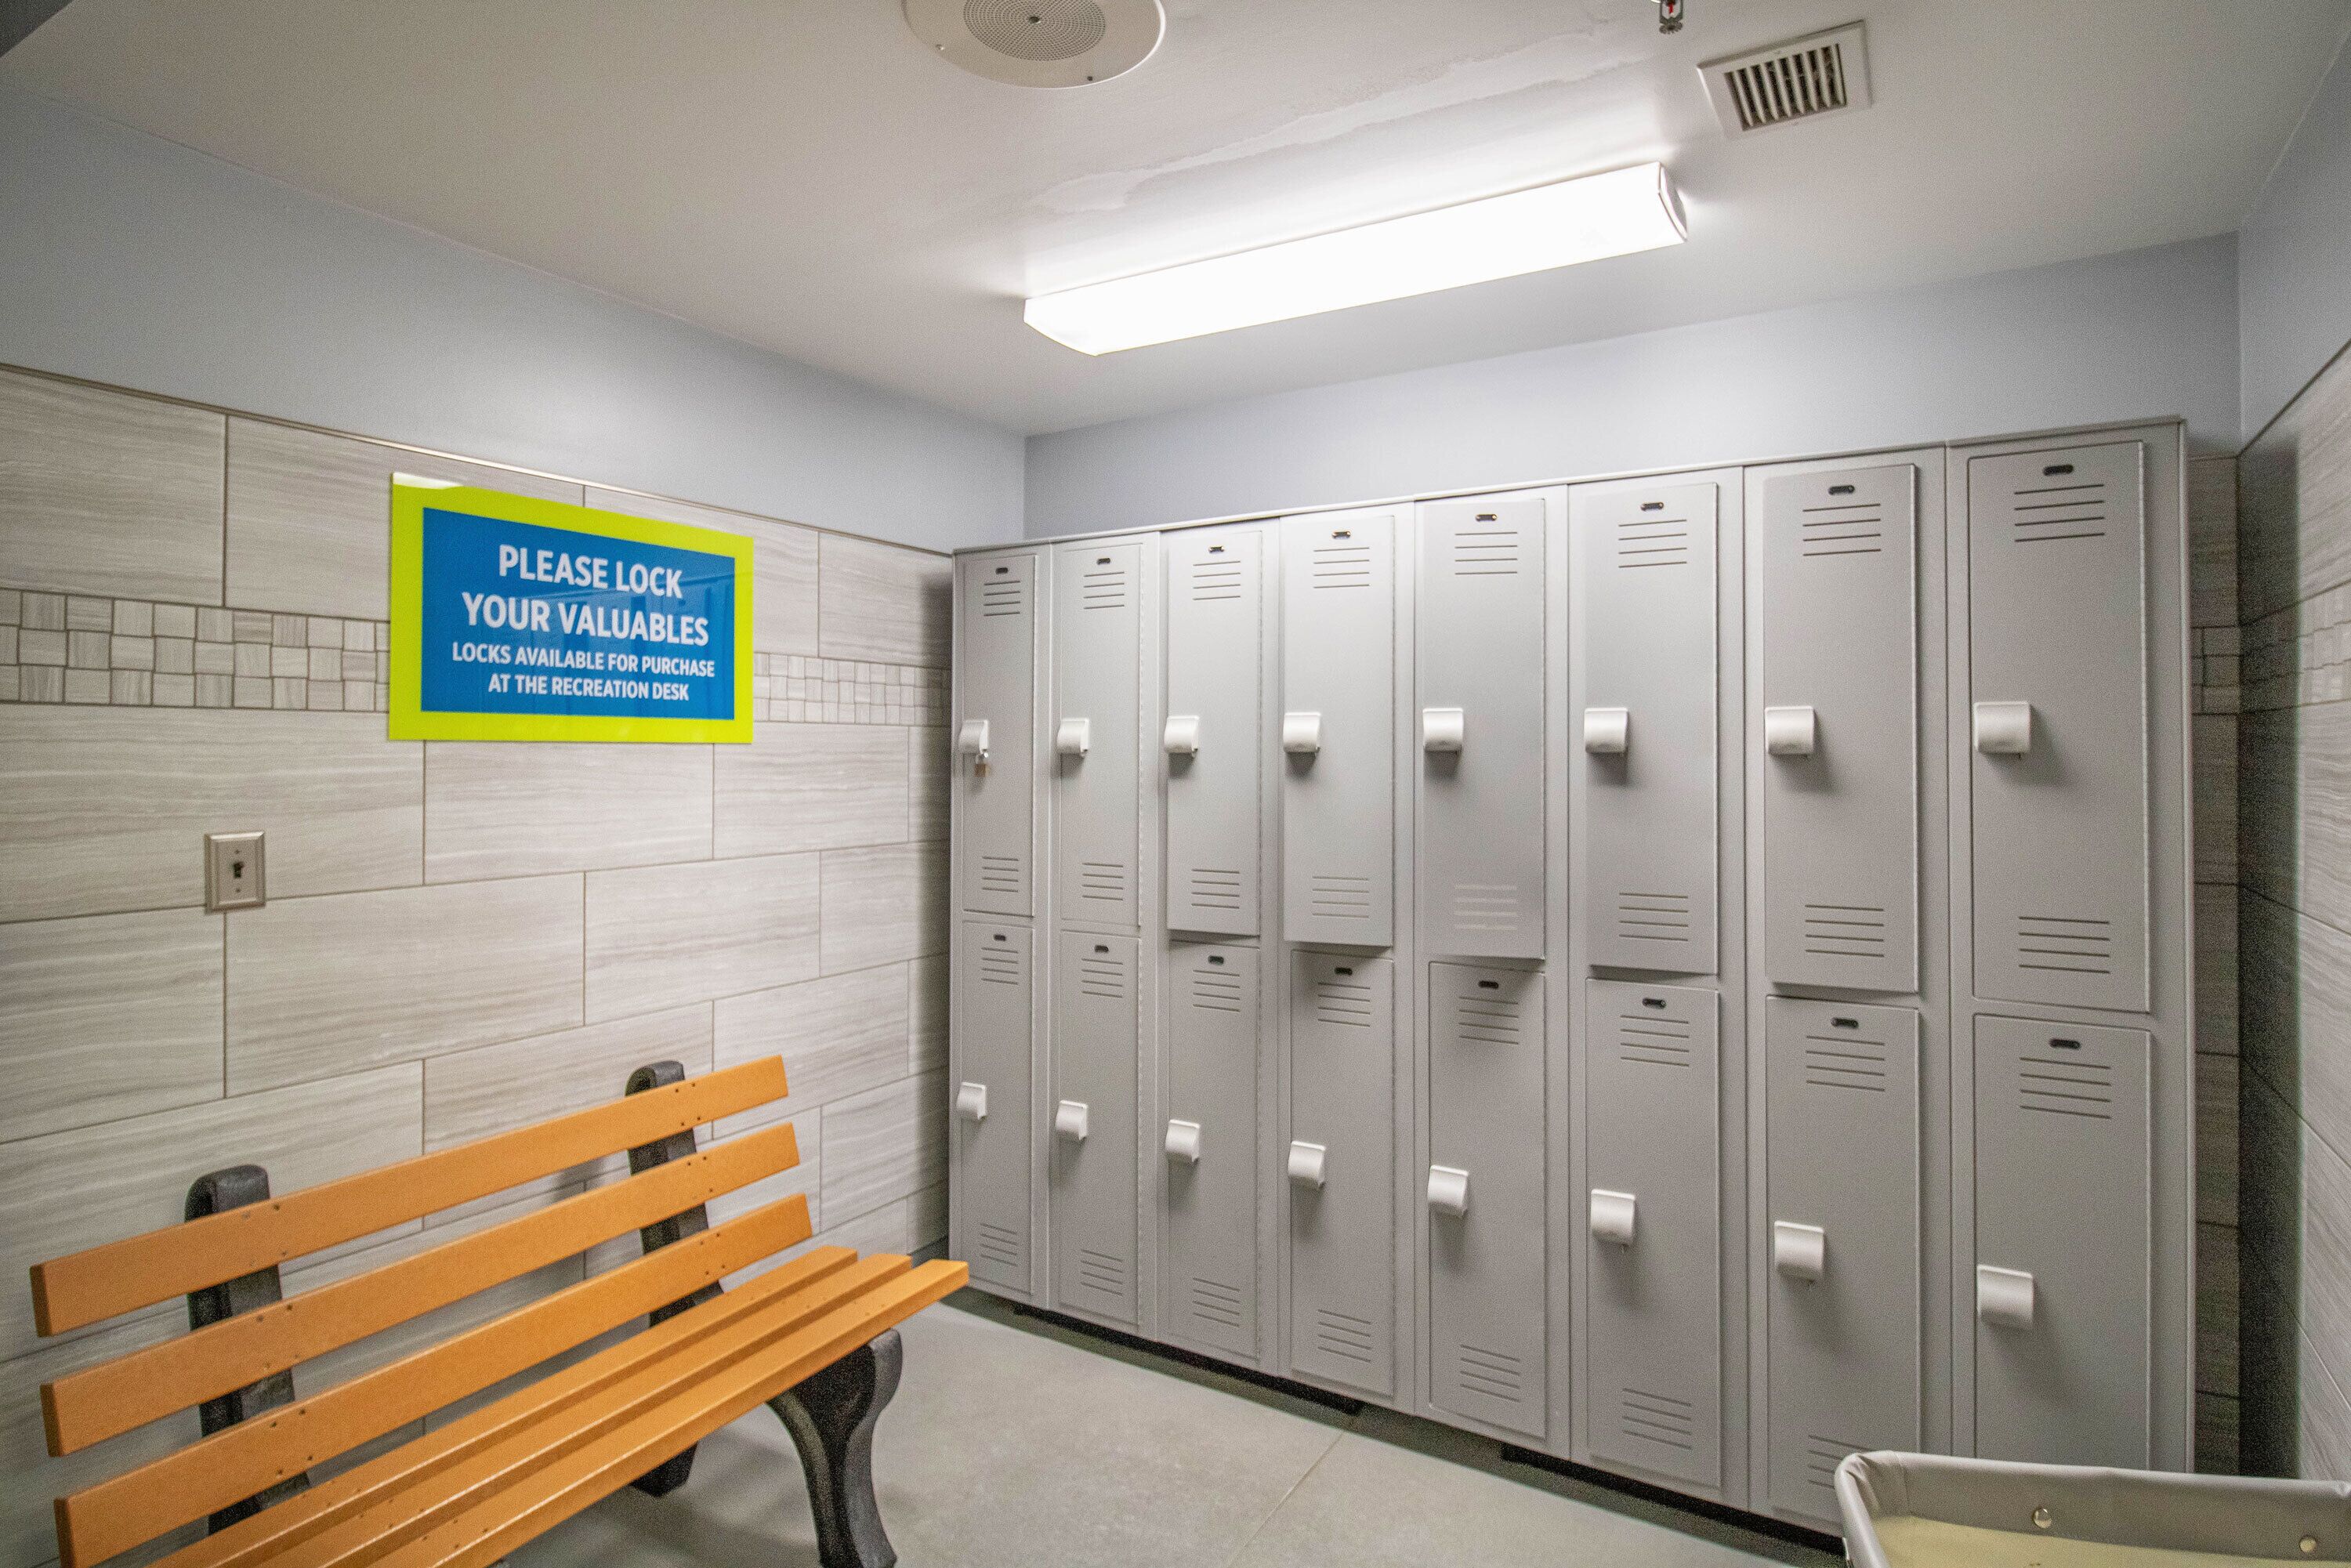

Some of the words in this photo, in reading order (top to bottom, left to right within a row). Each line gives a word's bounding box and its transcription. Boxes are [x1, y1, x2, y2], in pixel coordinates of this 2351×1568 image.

[499, 545, 608, 589] PLEASE
[615, 561, 683, 599] LOCK
[462, 592, 551, 632] YOUR
[557, 602, 708, 646] VALUABLES
[452, 642, 512, 664] LOCKS
[515, 646, 604, 670] AVAILABLE
[607, 653, 639, 672] FOR
[641, 656, 715, 678] PURCHASE
[488, 673, 511, 693] AT
[514, 674, 548, 695] THE
[552, 676, 649, 699] RECREATION
[652, 682, 689, 701] DESK
